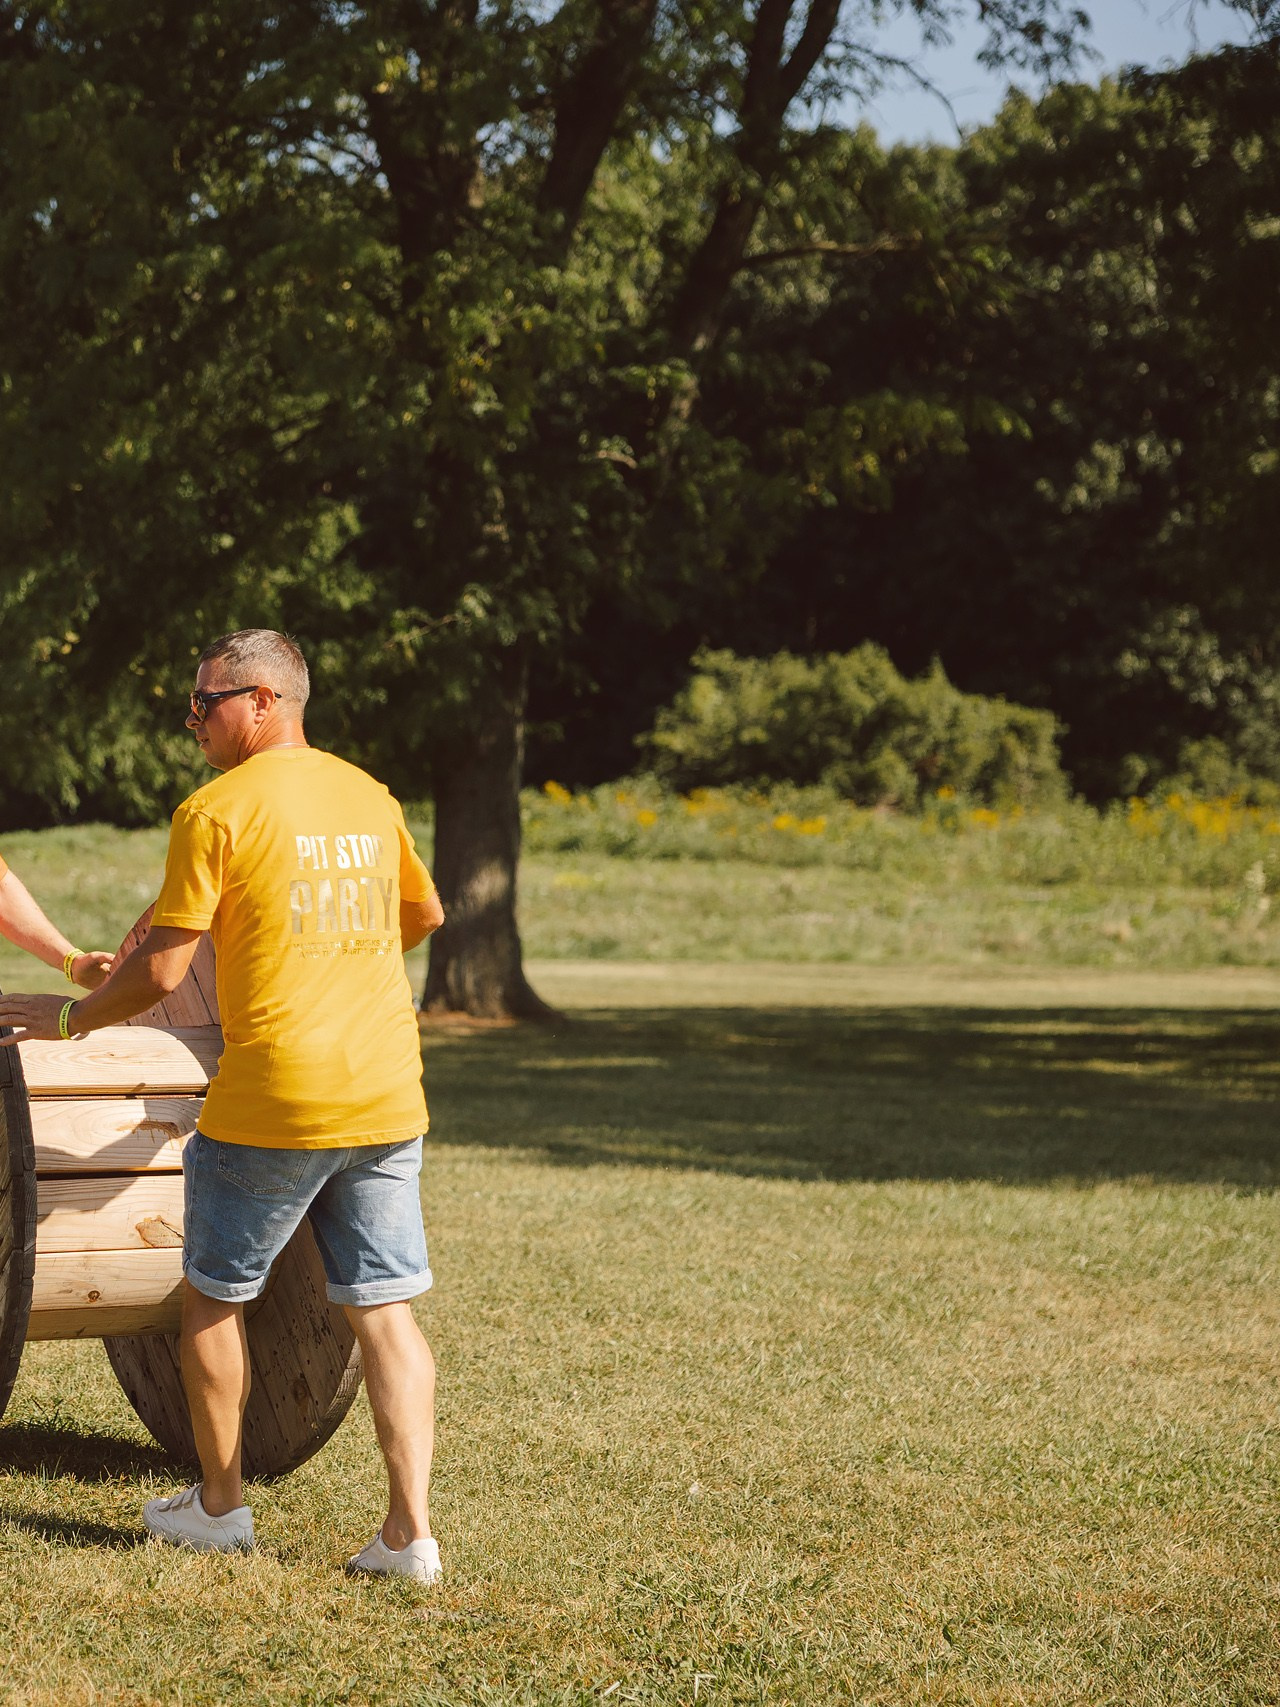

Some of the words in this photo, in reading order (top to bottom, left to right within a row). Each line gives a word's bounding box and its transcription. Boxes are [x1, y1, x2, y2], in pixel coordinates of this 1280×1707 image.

[295, 835, 329, 870] PIT
[334, 834, 384, 869] STOP
[289, 877, 393, 935] PARTY
